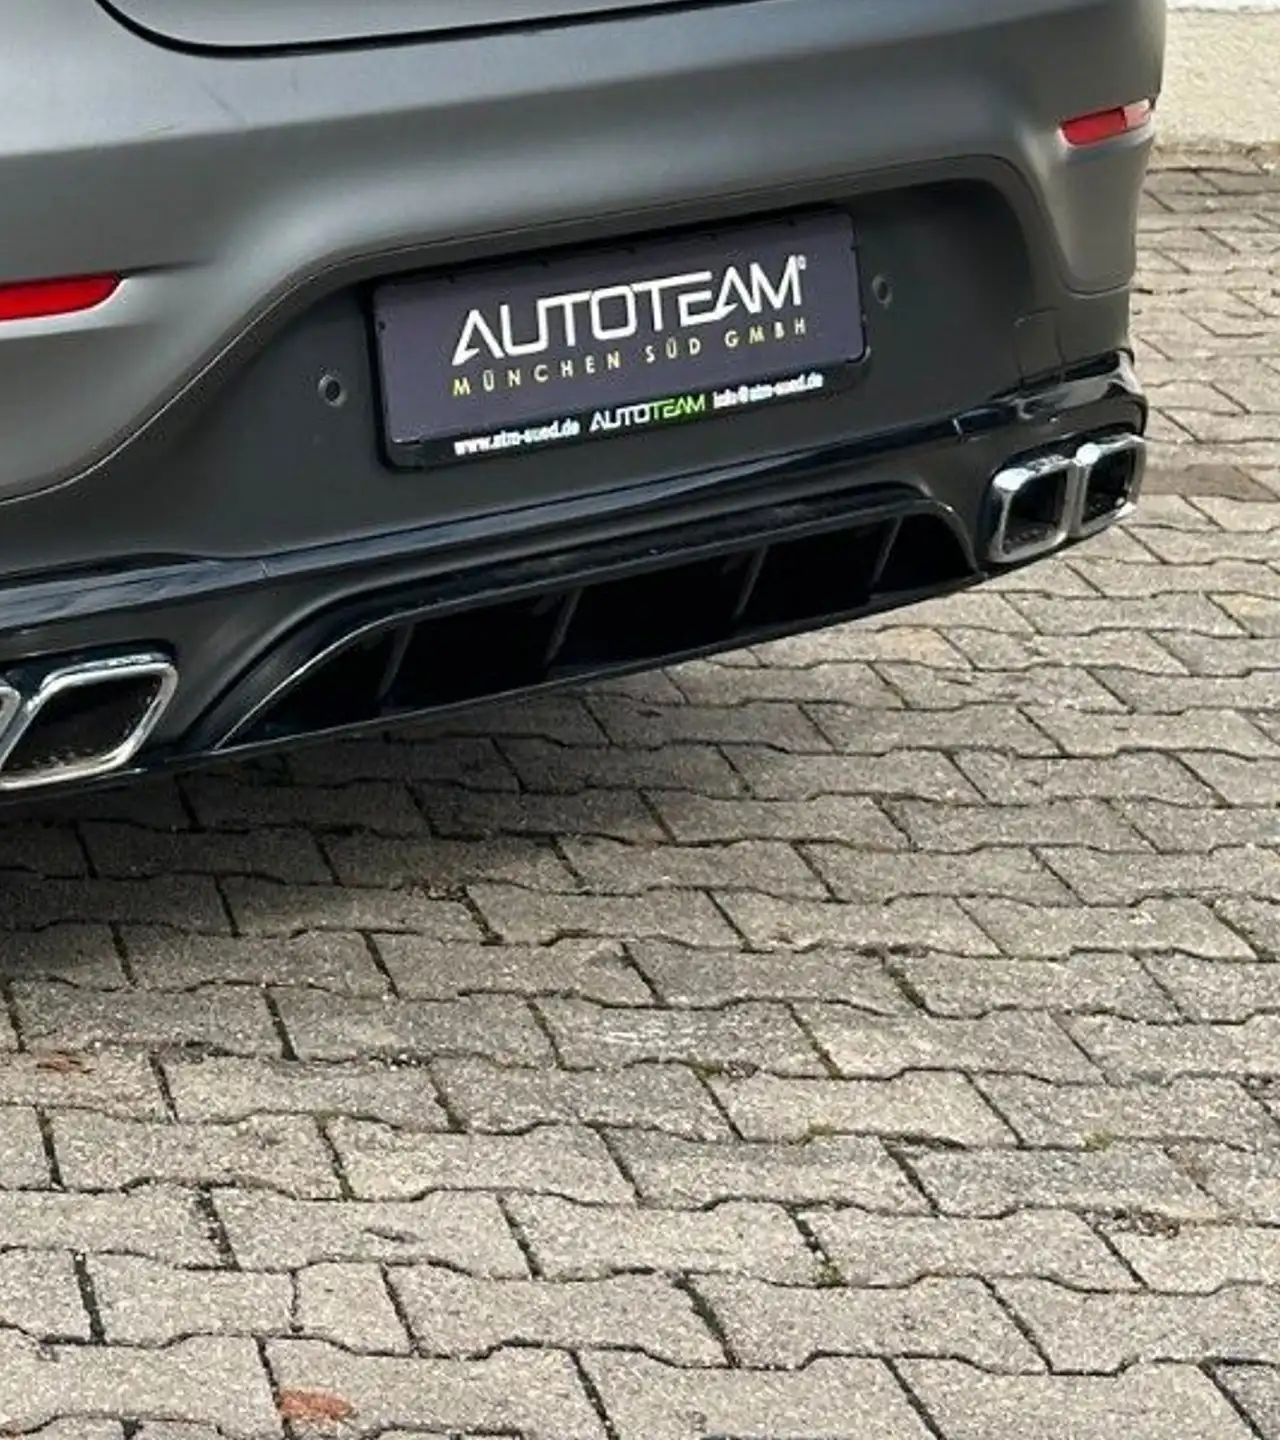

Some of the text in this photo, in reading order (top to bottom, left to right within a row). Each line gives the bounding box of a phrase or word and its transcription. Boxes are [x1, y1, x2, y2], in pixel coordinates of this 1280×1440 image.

[452, 316, 806, 397] MÜNCHEN SÜD GMBH
[589, 394, 706, 433] AUTOTEAM
